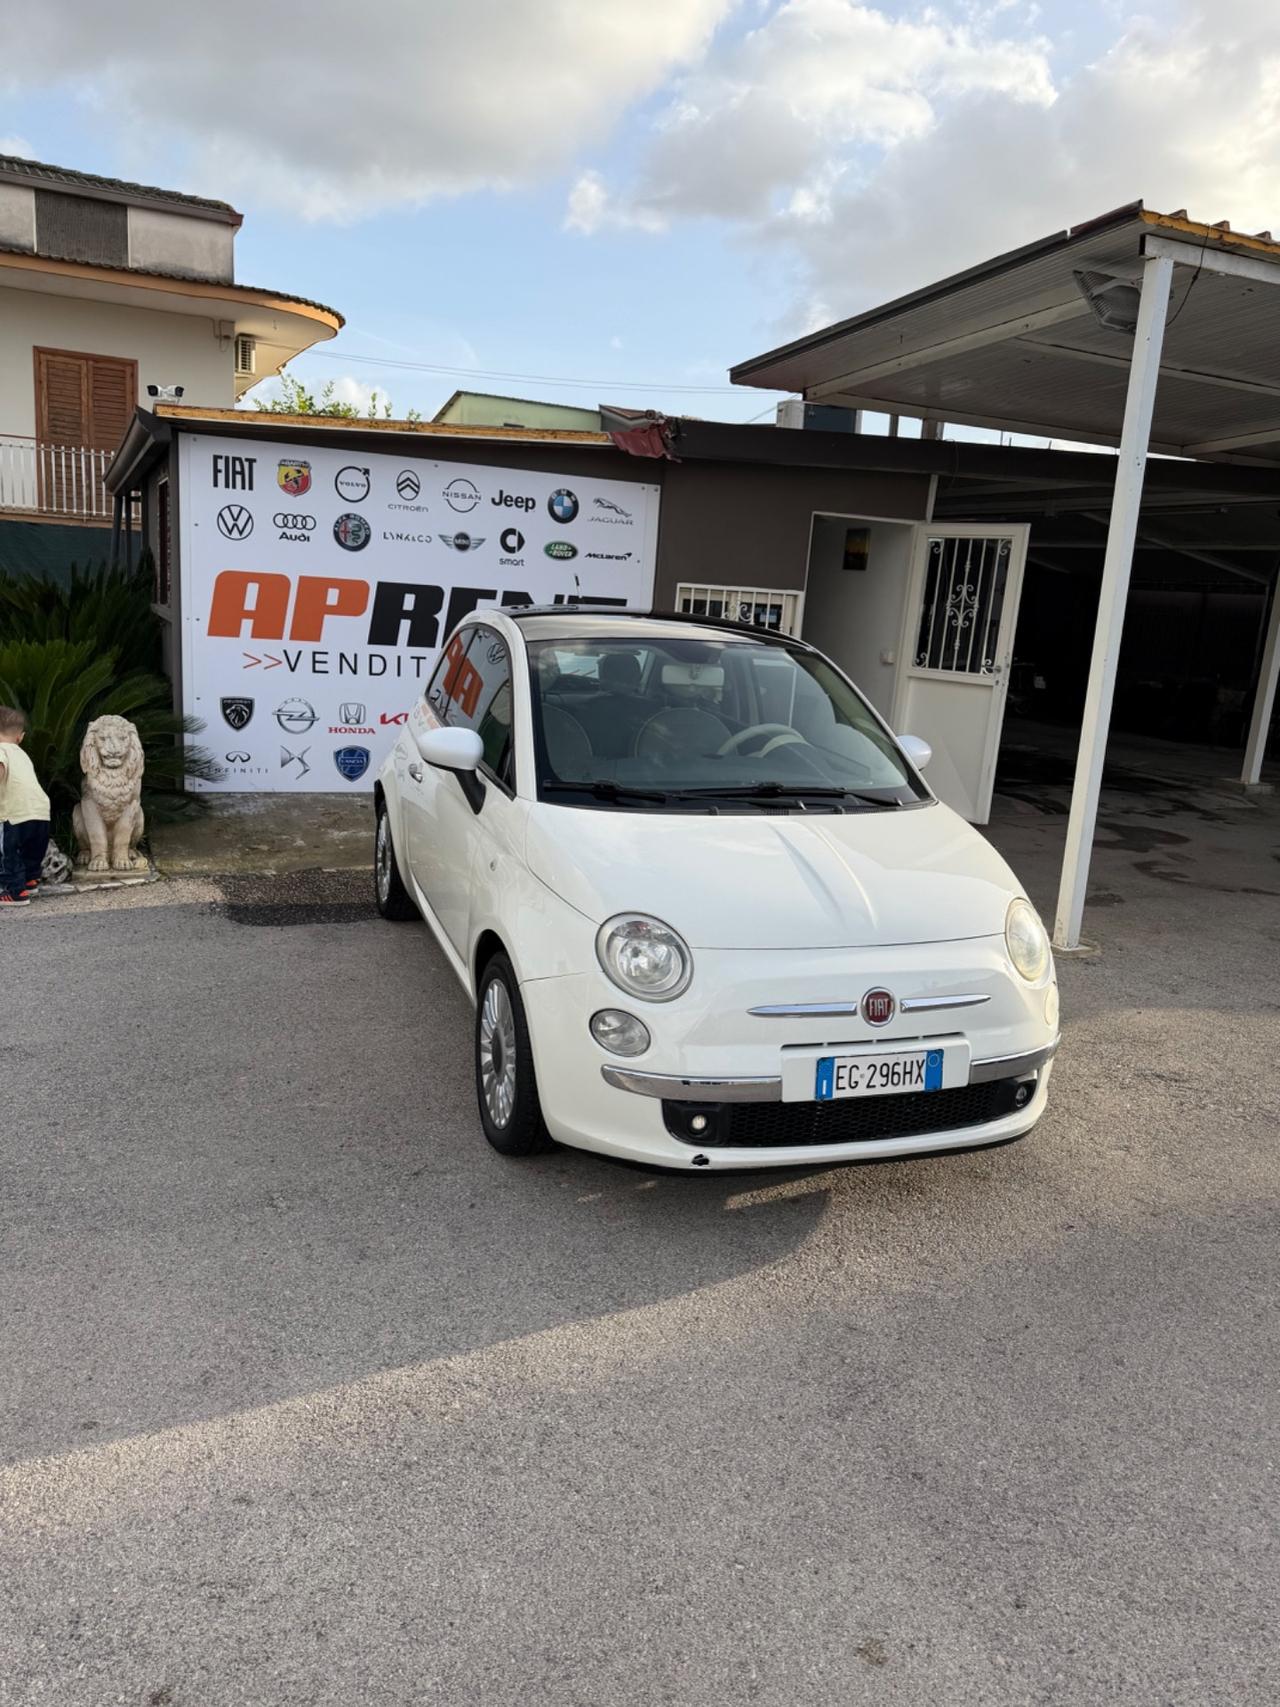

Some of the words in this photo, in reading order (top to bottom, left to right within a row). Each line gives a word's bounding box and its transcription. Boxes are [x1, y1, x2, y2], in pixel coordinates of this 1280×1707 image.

[212, 454, 257, 491] FIAT
[339, 480, 367, 488] VOLVO
[442, 490, 482, 501] NISSAN
[491, 489, 536, 512] Jeep
[588, 517, 634, 526] JAGUAR
[278, 531, 311, 542] Audi
[499, 558, 525, 567] smart
[283, 648, 427, 679] VENDIT
[328, 727, 376, 735] HONDA
[869, 998, 889, 1017] FIAT
[836, 1064, 860, 1091] EG
[866, 1059, 926, 1089] 296HX
